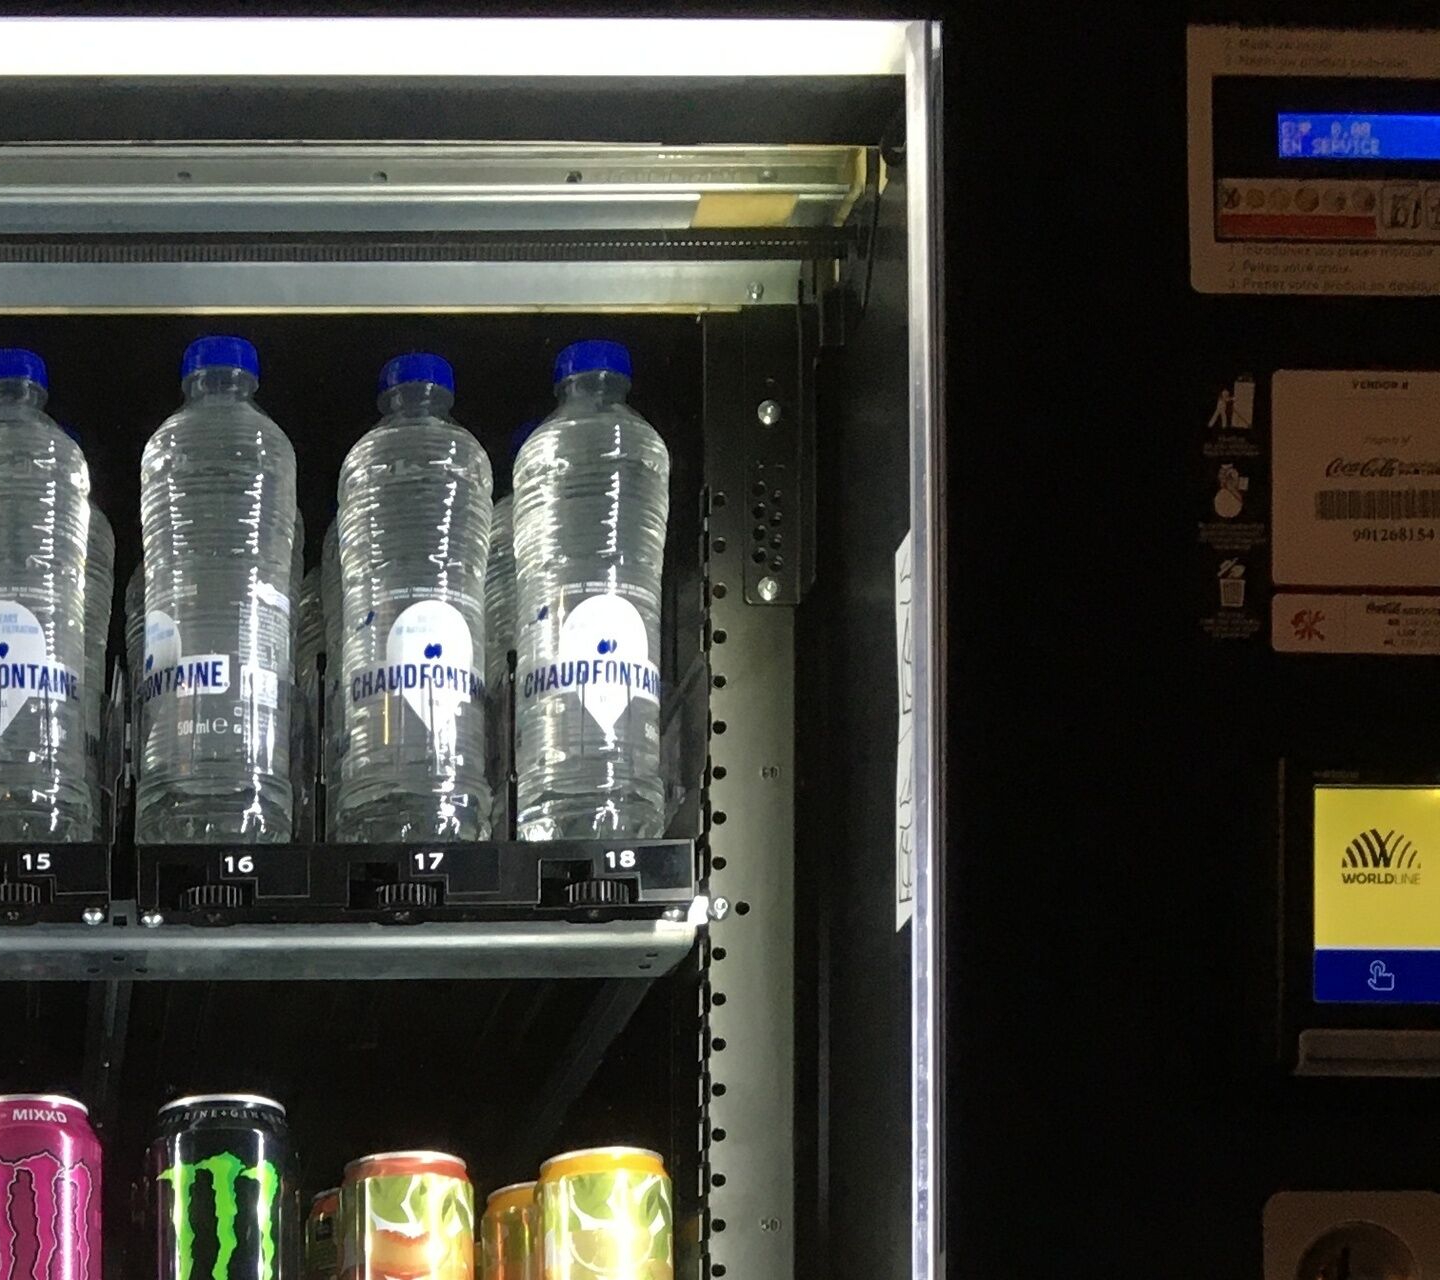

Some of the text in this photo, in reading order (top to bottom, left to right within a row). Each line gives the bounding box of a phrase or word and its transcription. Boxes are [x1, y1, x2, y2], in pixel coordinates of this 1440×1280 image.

[1352, 526, 1436, 542] 901268154
[22, 853, 51, 870] 15
[224, 855, 254, 873] 16
[414, 852, 444, 870] 17
[605, 849, 636, 869] 18
[1341, 871, 1422, 886] WORLDLINE
[11, 1108, 68, 1124] MIXXD
